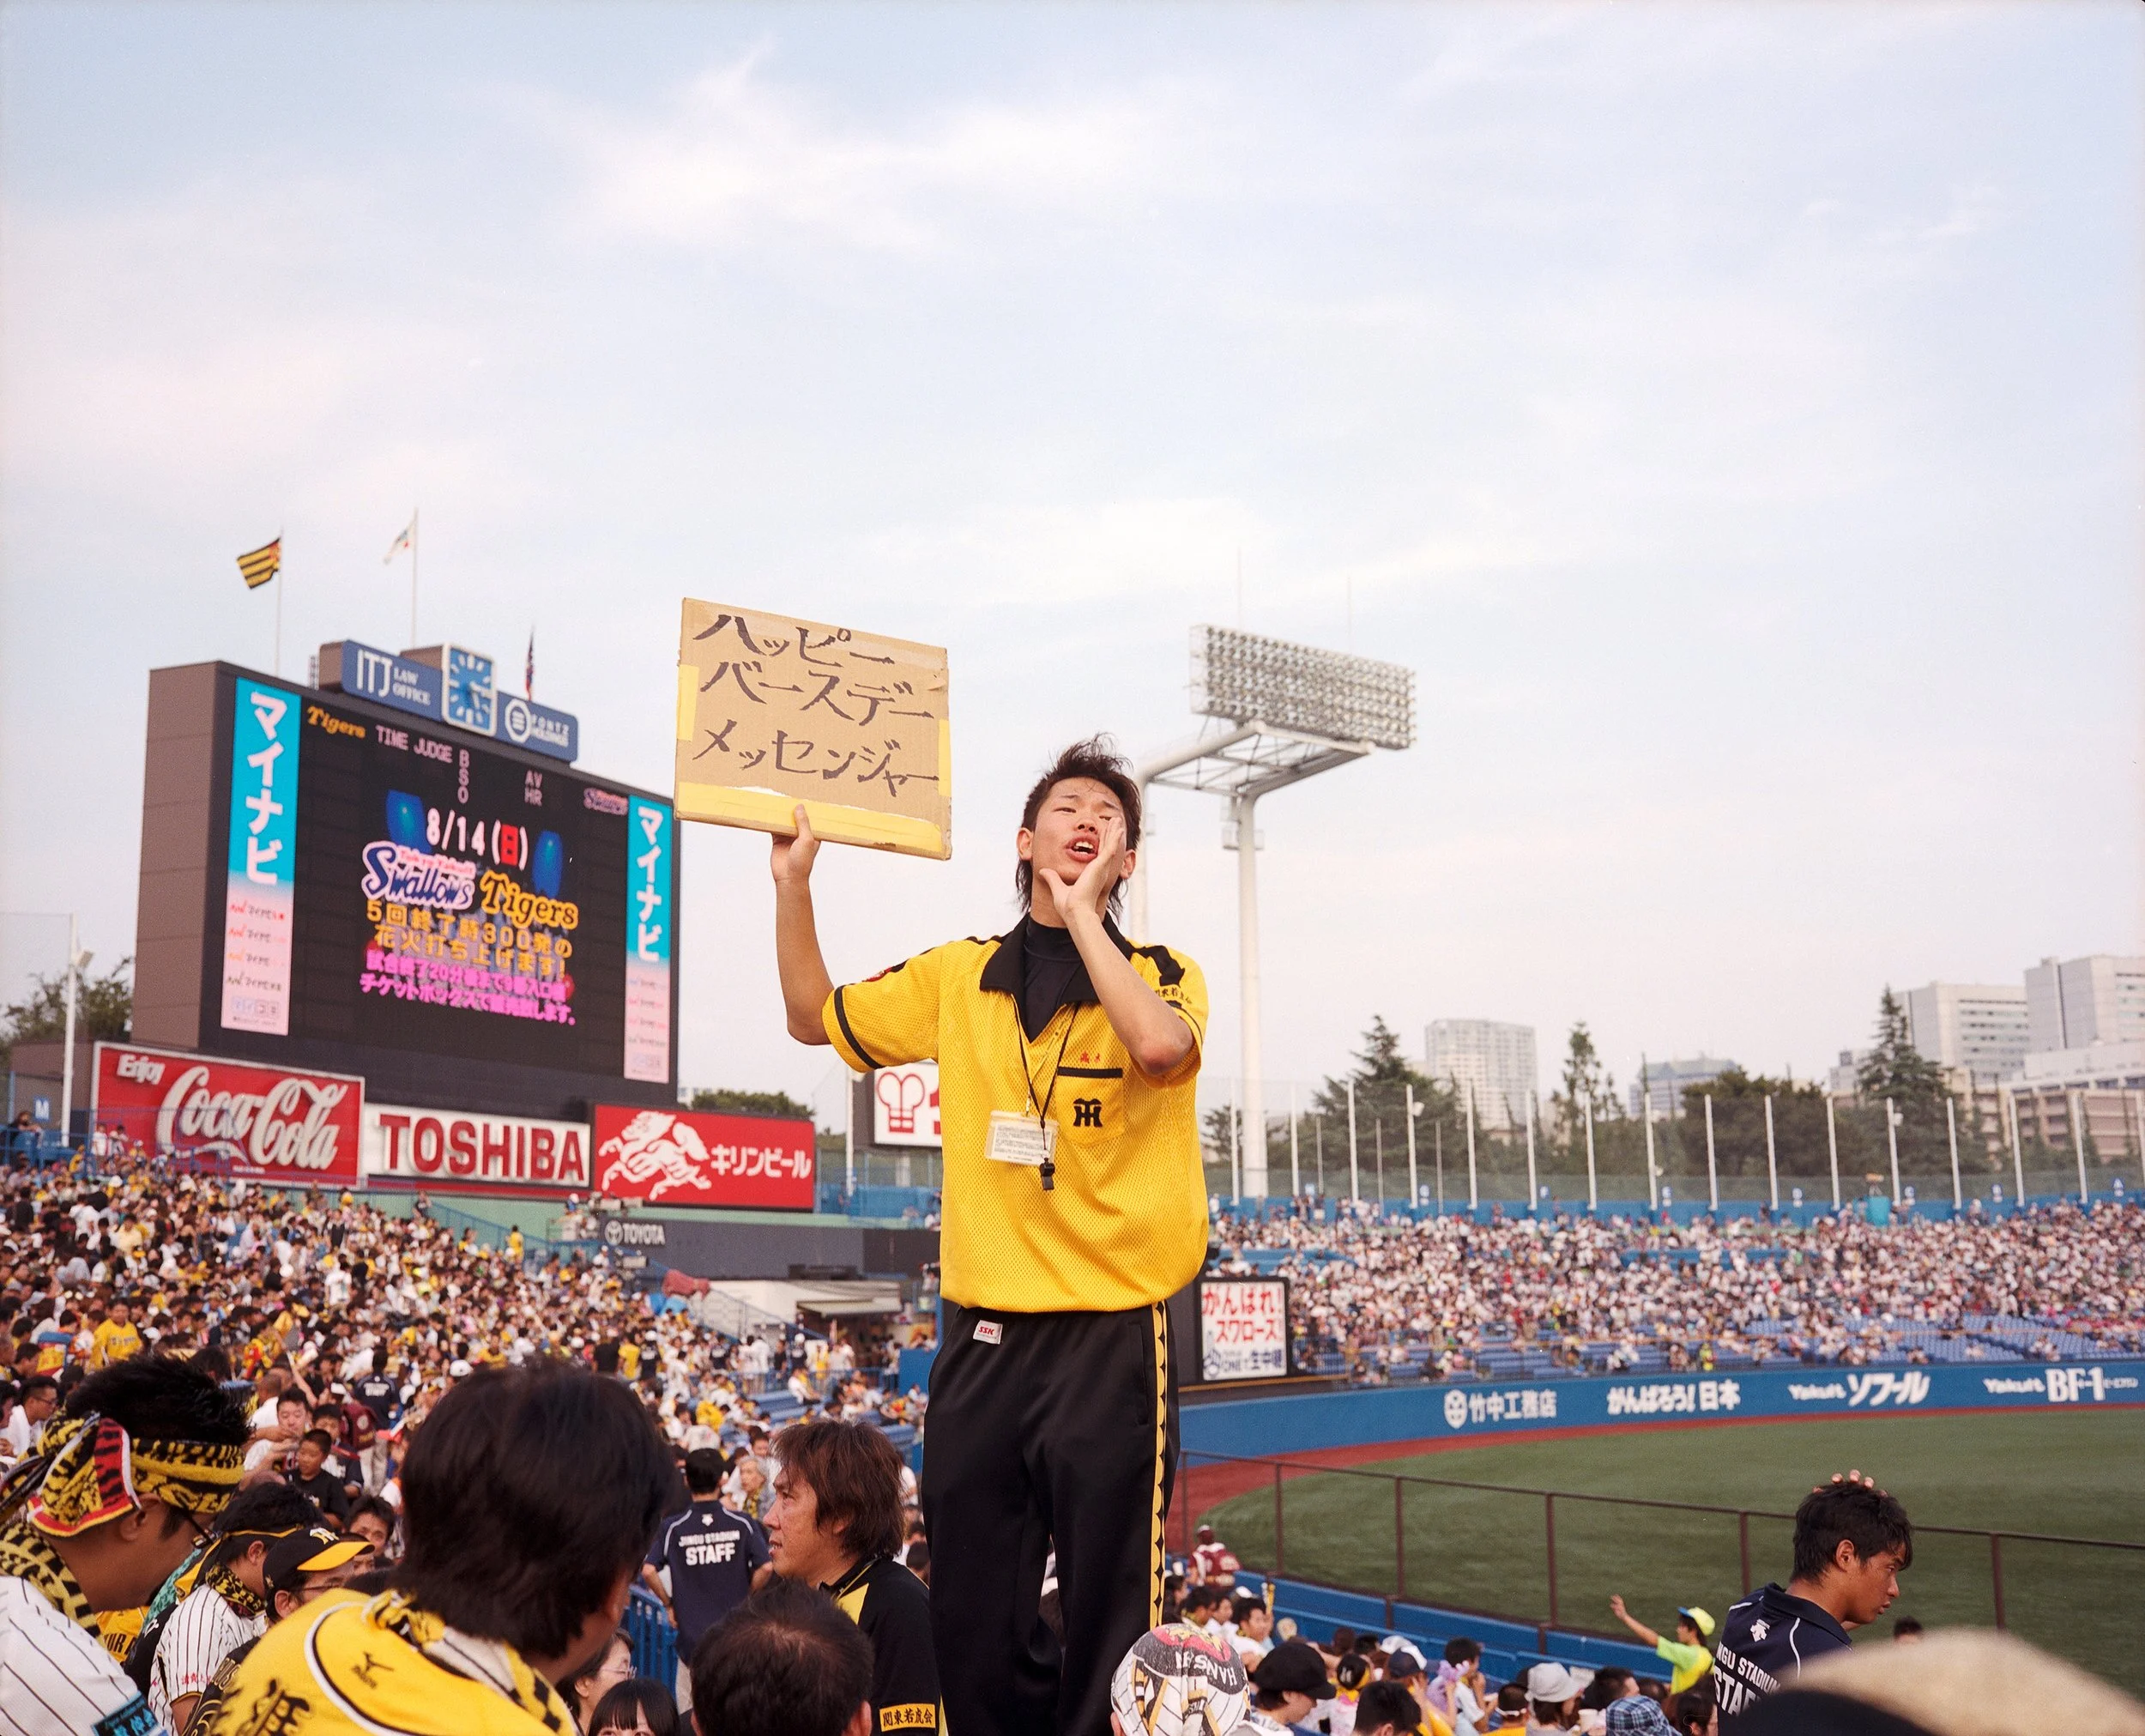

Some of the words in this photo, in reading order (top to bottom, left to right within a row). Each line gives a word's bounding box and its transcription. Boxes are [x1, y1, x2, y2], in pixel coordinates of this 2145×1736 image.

[692, 614, 896, 668] ハッピー
[357, 649, 392, 698] ITJ
[394, 666, 419, 687] LAW
[393, 682, 431, 705] OFFICE
[699, 660, 935, 727] バースデー
[307, 705, 366, 739] Tigers
[376, 724, 409, 751] TIME
[414, 737, 454, 764] JUDGE
[459, 749, 470, 768] B
[692, 718, 940, 798] メッセンジャー
[245, 691, 287, 886] マイナビ
[458, 768, 469, 786] S
[525, 770, 542, 789] AV
[524, 787, 542, 807] HR
[426, 808, 529, 872] 8/14(日)
[361, 840, 475, 910] Swallows
[480, 869, 579, 931] Tigers
[637, 806, 663, 962] マイナビ
[117, 1054, 166, 1084] Enjoy
[380, 1115, 584, 1182] TOSHIBA
[710, 1143, 812, 1180] キリンビール
[622, 1222, 666, 1245] TOYOTA
[978, 1326, 994, 1335] SSK
[1468, 1381, 1557, 1424] 竹中工務店
[1787, 1382, 1846, 1400] Yakult
[1846, 1370, 1931, 1406] ソフール
[1982, 1377, 2046, 1394] Yakult
[686, 1542, 735, 1566] STAFF
[1714, 1665, 1761, 1716] STAF
[882, 1707, 934, 1727] 関東若虎会
